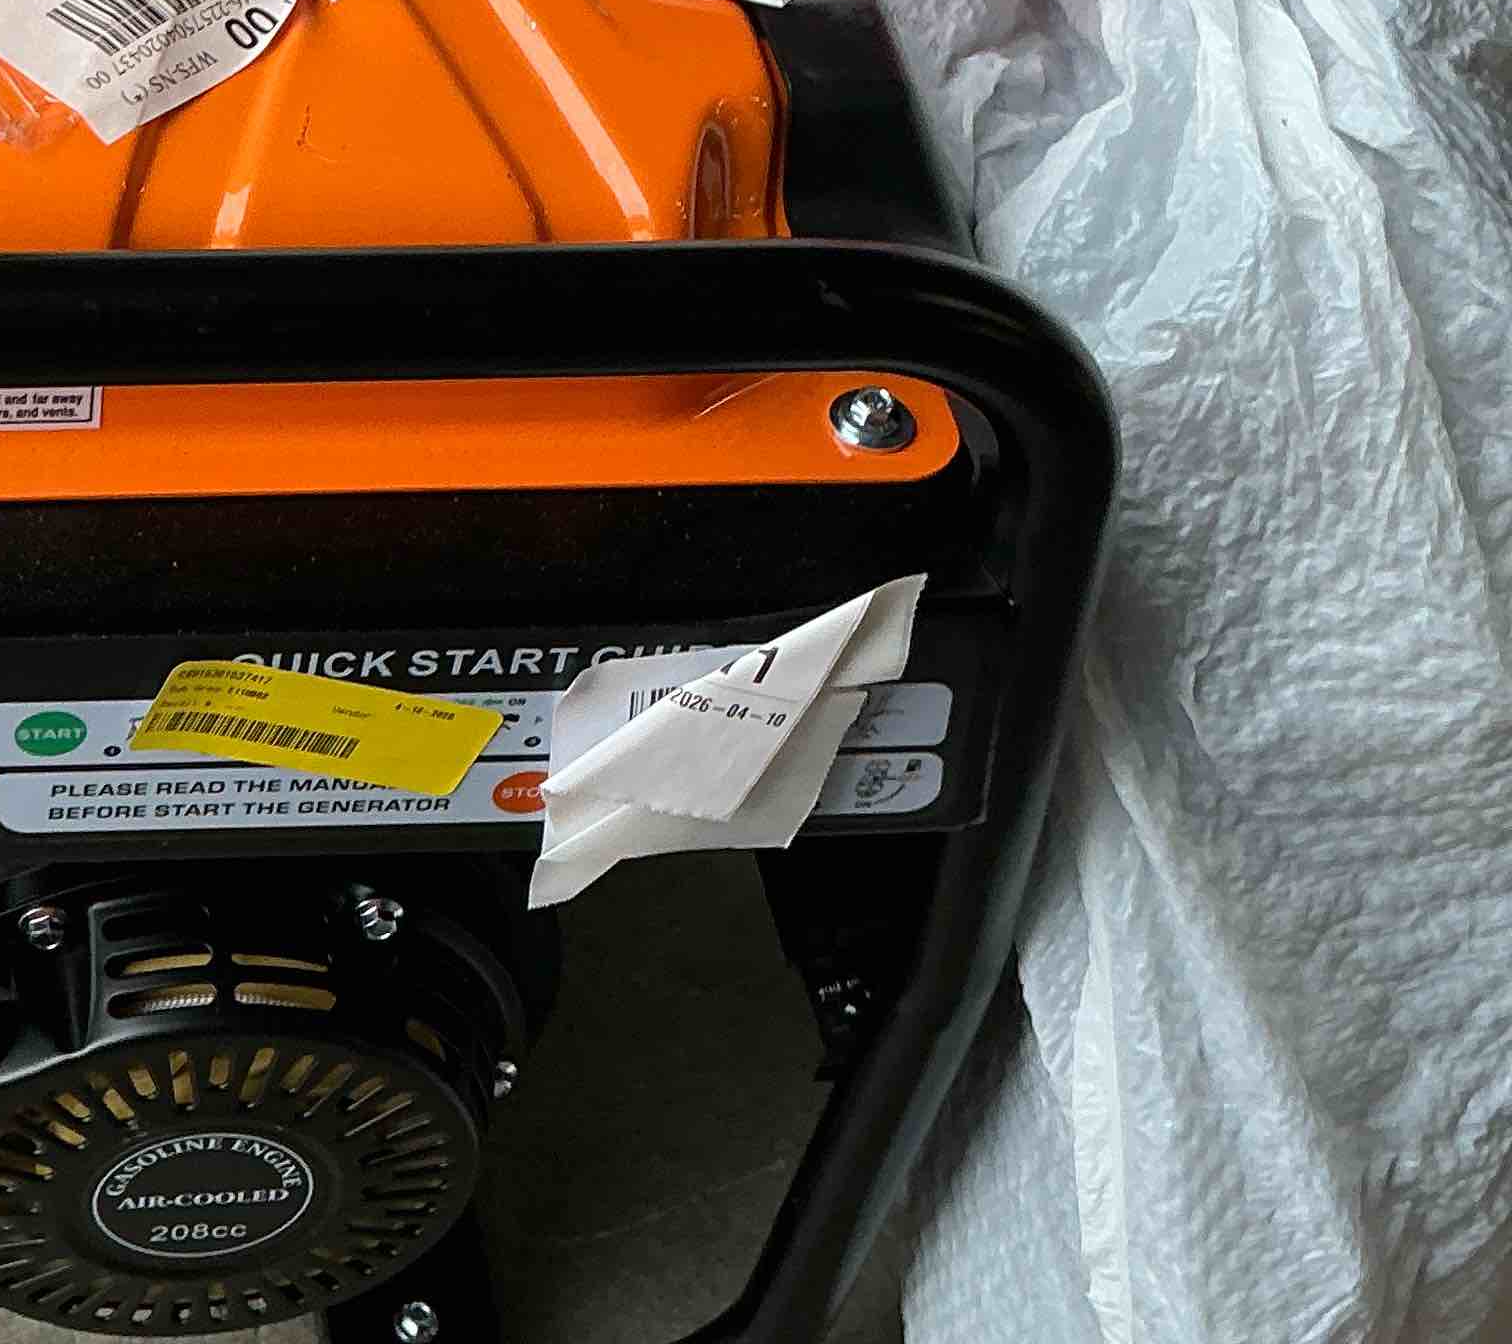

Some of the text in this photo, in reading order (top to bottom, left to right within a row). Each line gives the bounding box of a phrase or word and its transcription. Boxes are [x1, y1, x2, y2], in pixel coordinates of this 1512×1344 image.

[154, 49, 218, 95] WFS-NS
[4, 394, 28, 405] and
[32, 394, 48, 404] far
[51, 394, 83, 406] away
[16, 407, 39, 418] and
[408, 647, 579, 678] START
[671, 687, 787, 728] 2026-04-10
[17, 727, 83, 741] START
[50, 782, 149, 798] PLEASE
[156, 781, 225, 796] READ
[233, 779, 282, 794] THE
[500, 787, 547, 800] STO
[48, 797, 451, 820] BEFORE START THE GENERATOR
[106, 1138, 304, 1197] GASOLINE ENGINE
[117, 1188, 290, 1211] AIR-COOLED
[149, 1223, 248, 1243] 208cc
